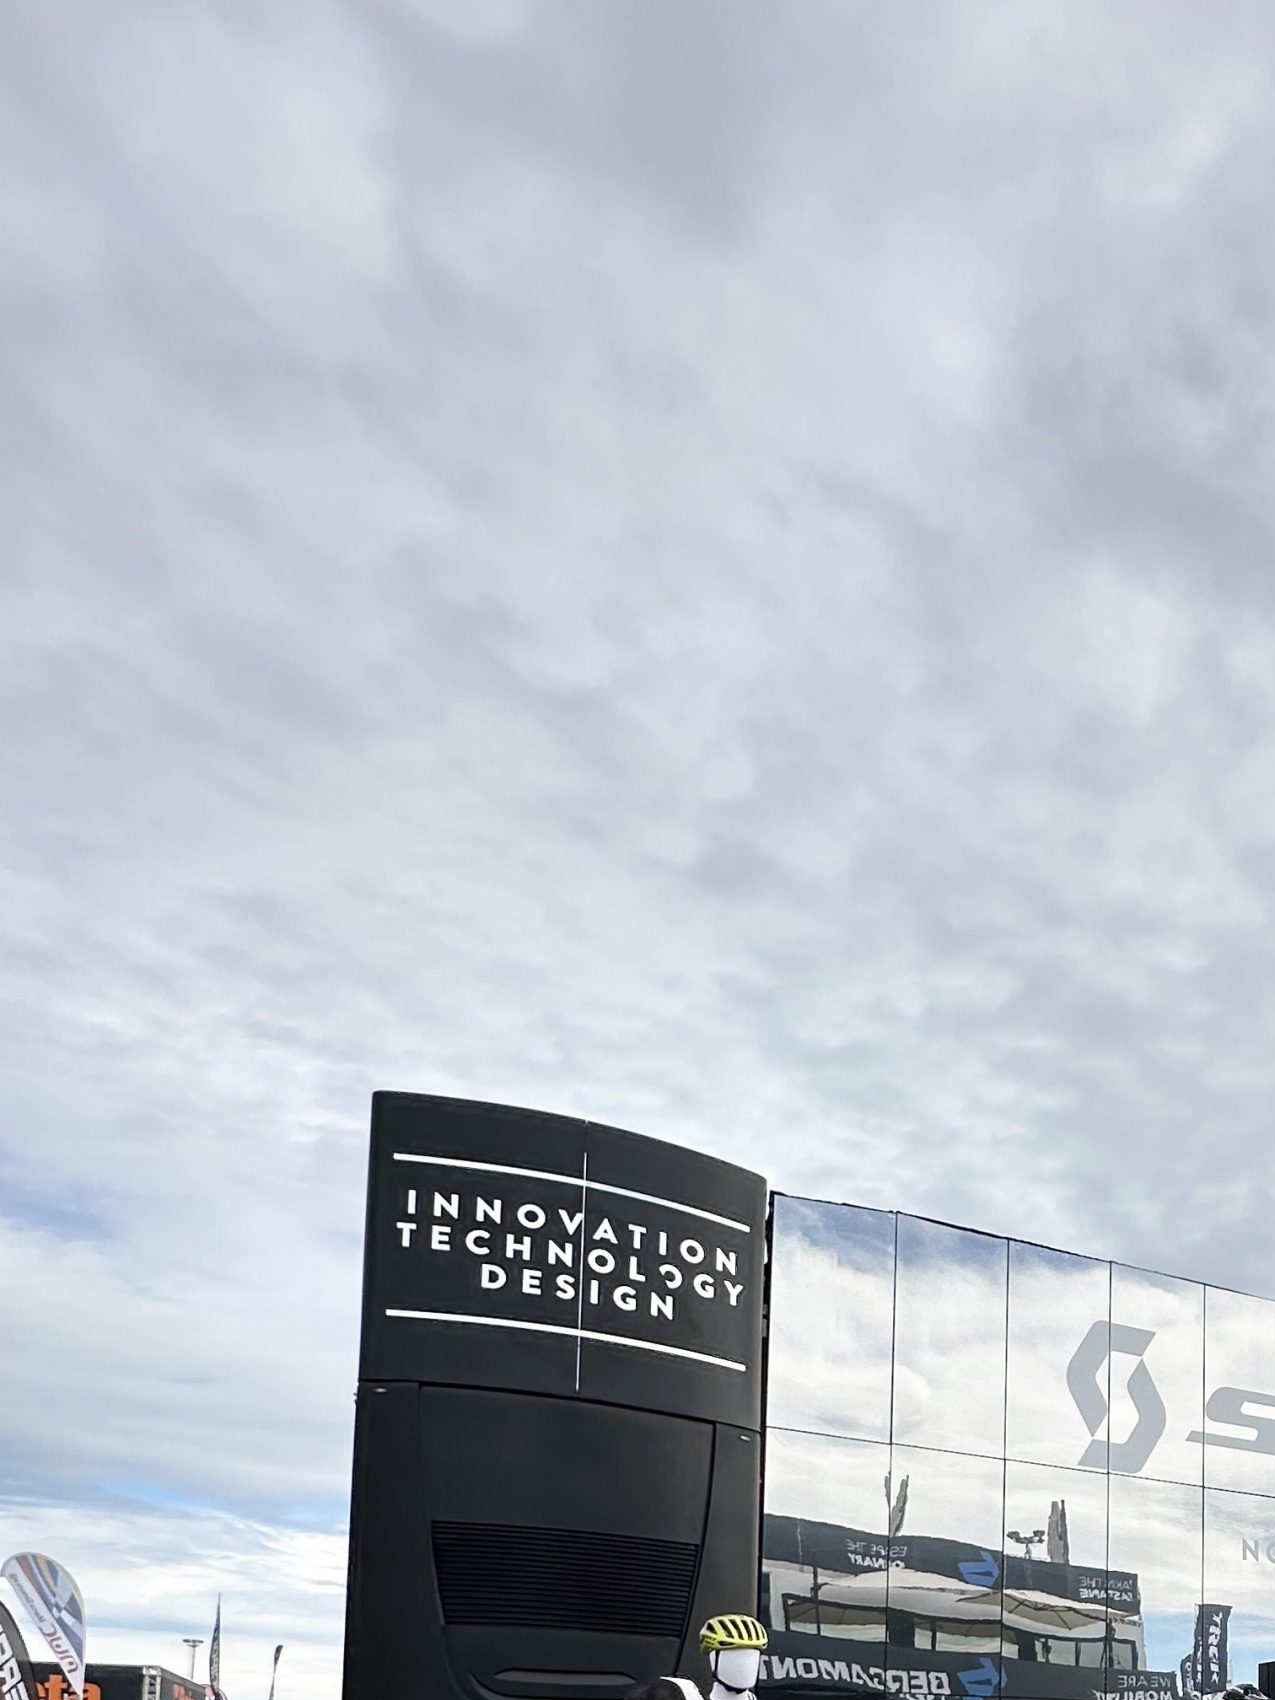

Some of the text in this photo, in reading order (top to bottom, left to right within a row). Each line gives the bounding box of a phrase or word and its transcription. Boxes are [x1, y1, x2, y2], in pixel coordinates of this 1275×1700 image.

[396, 1221, 744, 1306] TECHNOLOGY
[405, 1189, 738, 1276] INNOVATION
[481, 1263, 676, 1320] DESIGN
